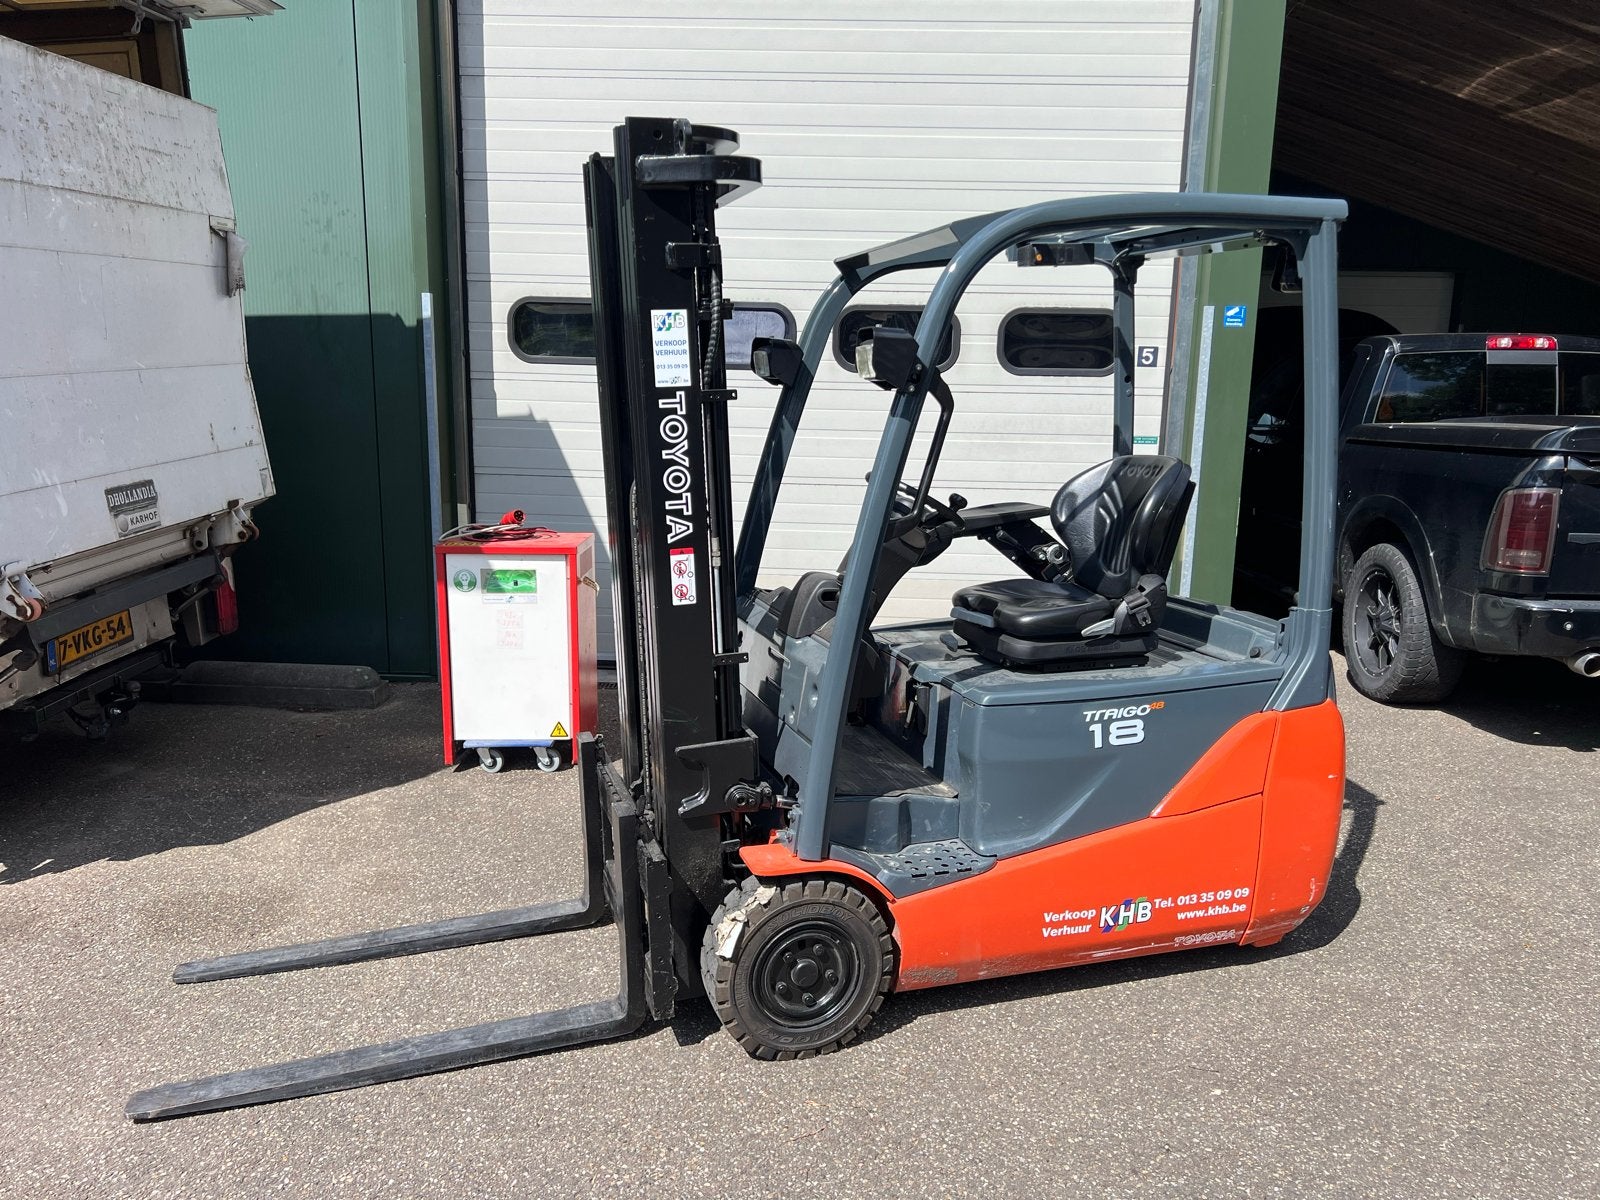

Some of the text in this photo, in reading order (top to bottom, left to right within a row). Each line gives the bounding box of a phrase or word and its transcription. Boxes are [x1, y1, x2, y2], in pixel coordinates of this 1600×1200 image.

[653, 314, 686, 329] KHB
[655, 339, 687, 347] VERKOOP
[1141, 348, 1154, 365] 5
[658, 391, 694, 544] TOYOTA
[107, 485, 156, 507] DHOLLANDIA
[130, 511, 158, 526] KARHOF
[59, 616, 126, 661] 7-VKG-54
[1088, 719, 1145, 749] 18
[1154, 887, 1250, 909] Tel. 013 35 09 09
[1043, 909, 1097, 923] Verkoop
[1099, 898, 1152, 931] KHB
[1177, 903, 1247, 920] www.khb.be
[1042, 924, 1092, 938] Verhuur
